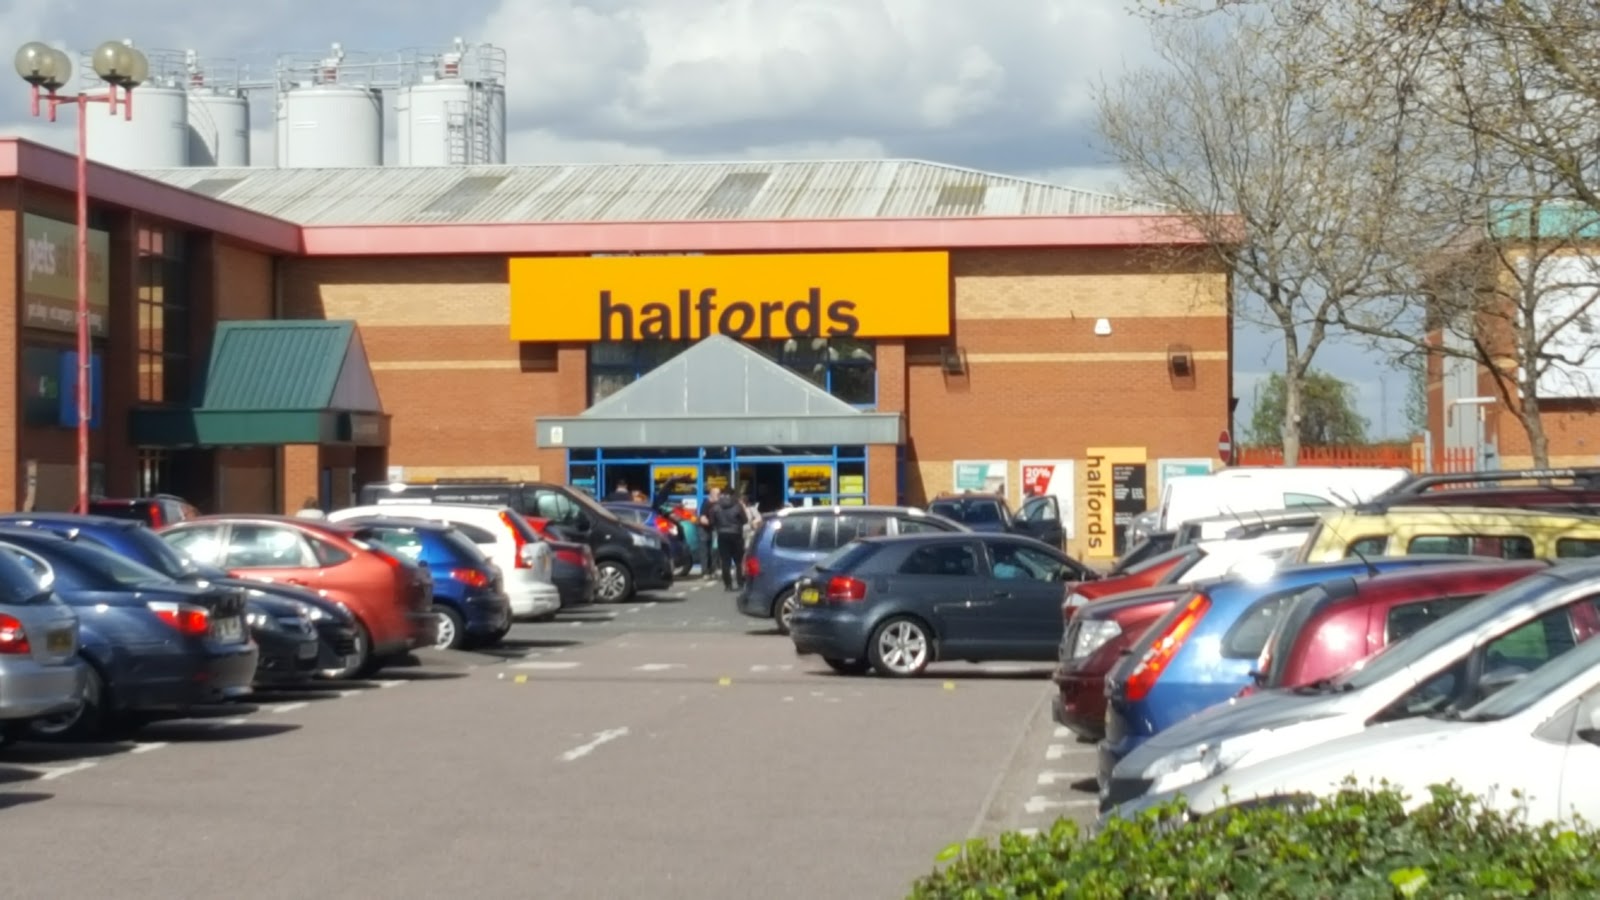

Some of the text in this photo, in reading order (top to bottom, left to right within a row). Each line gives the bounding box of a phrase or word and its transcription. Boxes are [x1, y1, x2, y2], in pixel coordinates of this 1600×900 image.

[599, 287, 860, 339] halfords
[1025, 467, 1050, 479] 20%
[1087, 455, 1106, 549] halfords
